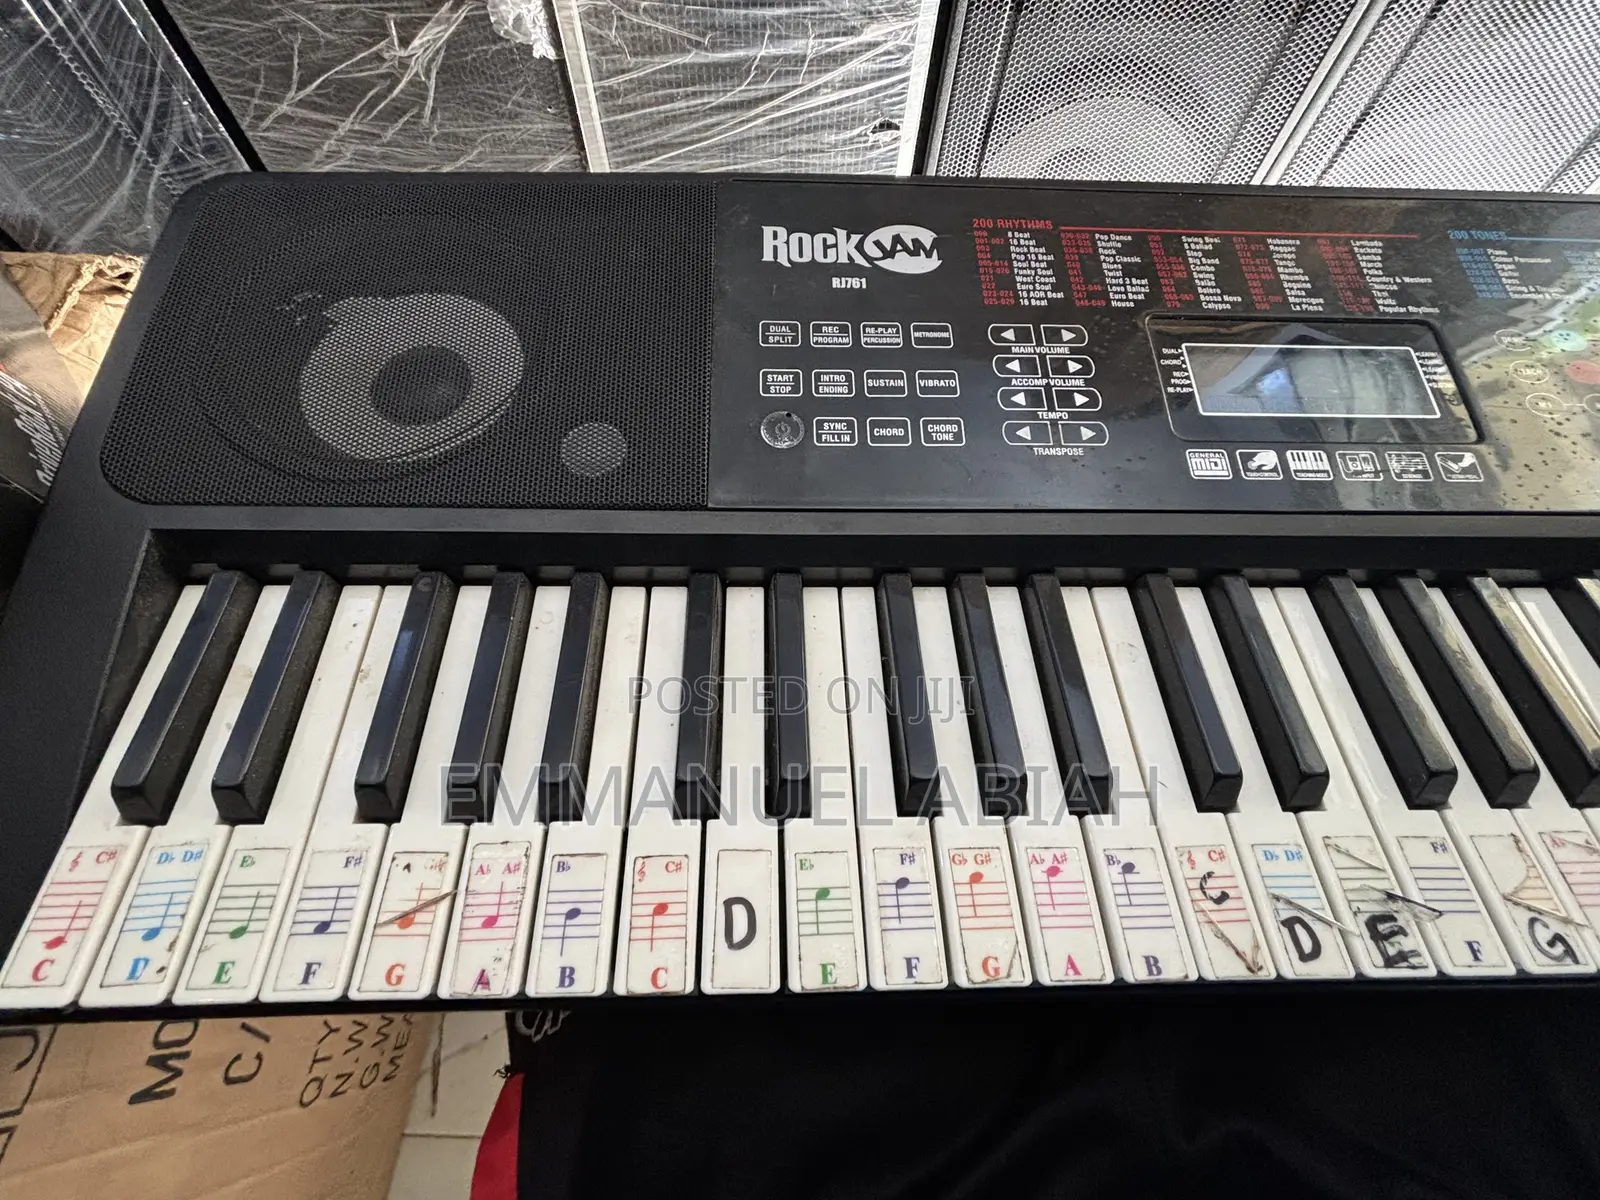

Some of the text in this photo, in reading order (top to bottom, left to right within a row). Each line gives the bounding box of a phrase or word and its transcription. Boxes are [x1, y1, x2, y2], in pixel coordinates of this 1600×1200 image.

[973, 219, 1053, 229] 200 RHYTHMS
[1472, 231, 1508, 240] TONES
[1188, 257, 1200, 265] Big
[832, 277, 866, 288] RJ761
[1193, 272, 1215, 280] Swing
[1202, 302, 1231, 310] Calypso
[813, 336, 849, 344] PROGRAM
[767, 374, 794, 382] START
[821, 374, 846, 382] INTRO
[868, 379, 904, 387] SUSTAIN
[919, 379, 955, 387] VIBRATO
[1011, 378, 1048, 386] ACCOMP
[770, 386, 791, 394] STOP
[819, 386, 849, 394] ENDING
[822, 434, 850, 442] FILL IN
[874, 428, 905, 436] CHORD
[928, 424, 958, 432] CHORD
[932, 433, 954, 441] TONE
[723, 896, 757, 950] D
[1281, 915, 1322, 963] D
[1364, 913, 1422, 969] E
[1527, 916, 1580, 965] G
[1464, 940, 1484, 962] F
[32, 959, 54, 982] C
[126, 957, 150, 981] D
[213, 960, 236, 985] E
[299, 962, 322, 985] F
[385, 963, 405, 987] G
[820, 962, 838, 985] E
[904, 956, 920, 979] F
[981, 956, 1001, 978] G
[1064, 954, 1082, 976] A
[1142, 955, 1163, 977] B
[473, 968, 491, 992] A
[556, 966, 576, 989] B
[651, 967, 669, 990] C
[300, 1019, 341, 1108] QTY
